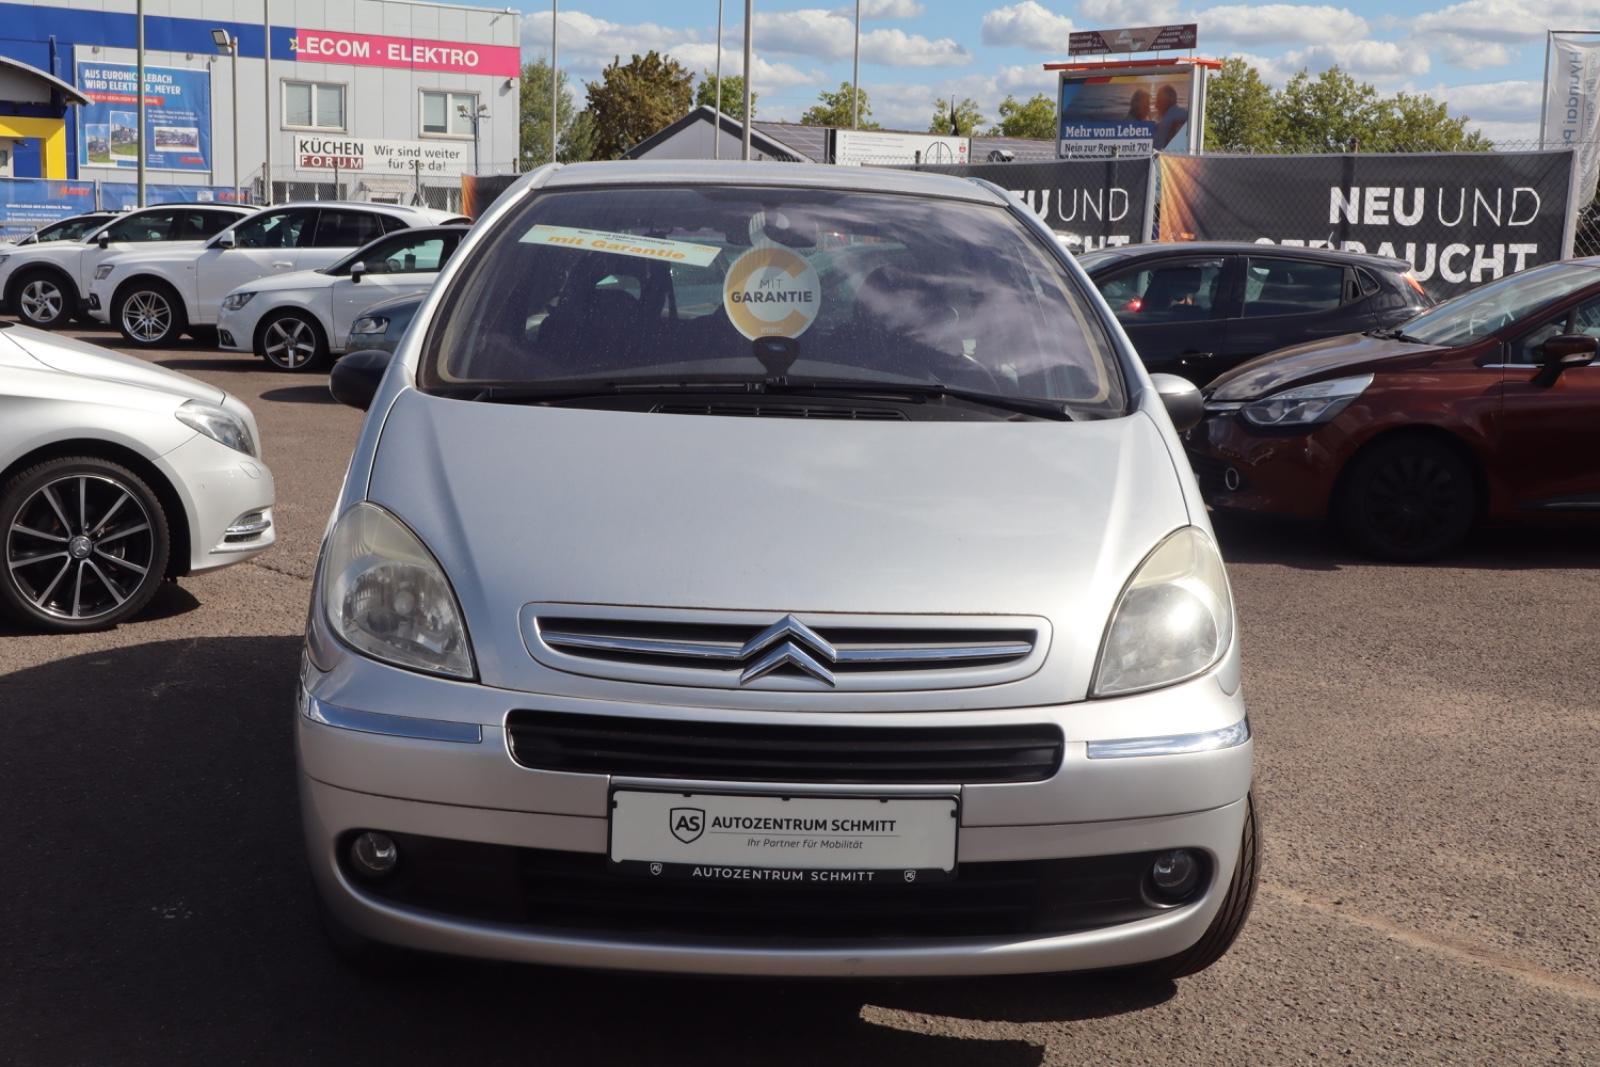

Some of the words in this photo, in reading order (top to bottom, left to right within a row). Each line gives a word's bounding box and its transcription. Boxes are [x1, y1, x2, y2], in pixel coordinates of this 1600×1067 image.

[387, 43, 480, 67] ELEKTRO
[84, 69, 100, 79] AUS
[102, 70, 138, 81] EURONIC
[85, 80, 108, 90] WIRD
[109, 81, 138, 92] ELEKTR
[154, 85, 181, 96] MEYER
[1065, 124, 1092, 137] Mehr
[1093, 127, 1115, 137] vom
[1117, 124, 1152, 137] Leben.
[299, 137, 364, 156] KÜCHEN
[374, 144, 394, 156] Wir
[397, 145, 421, 158] sind
[424, 147, 461, 160] weiter
[1064, 143, 1084, 153] Nein
[1121, 142, 1135, 152] mit
[1136, 142, 1150, 152] 70!
[300, 156, 364, 169] FORUM
[388, 157, 404, 170] für
[409, 159, 425, 171] Se
[428, 159, 446, 172] da!
[1057, 187, 1129, 222] UND
[1329, 186, 1425, 226] NEU
[1437, 187, 1541, 227] UND
[547, 234, 585, 246] mit
[591, 238, 686, 260] Garantie
[759, 278, 785, 289] MIT
[731, 290, 813, 303] GARANTIE
[675, 815, 700, 832] AS
[711, 815, 828, 832] AUTOZENTRUM
[831, 818, 897, 833] SCHMITT
[747, 838, 761, 847] Ihr
[763, 838, 800, 849] Partner
[802, 838, 819, 850] für
[820, 838, 863, 850] Mobilität
[692, 867, 804, 881] AUTOZENTRUM
[810, 870, 875, 882] SCHMITT
